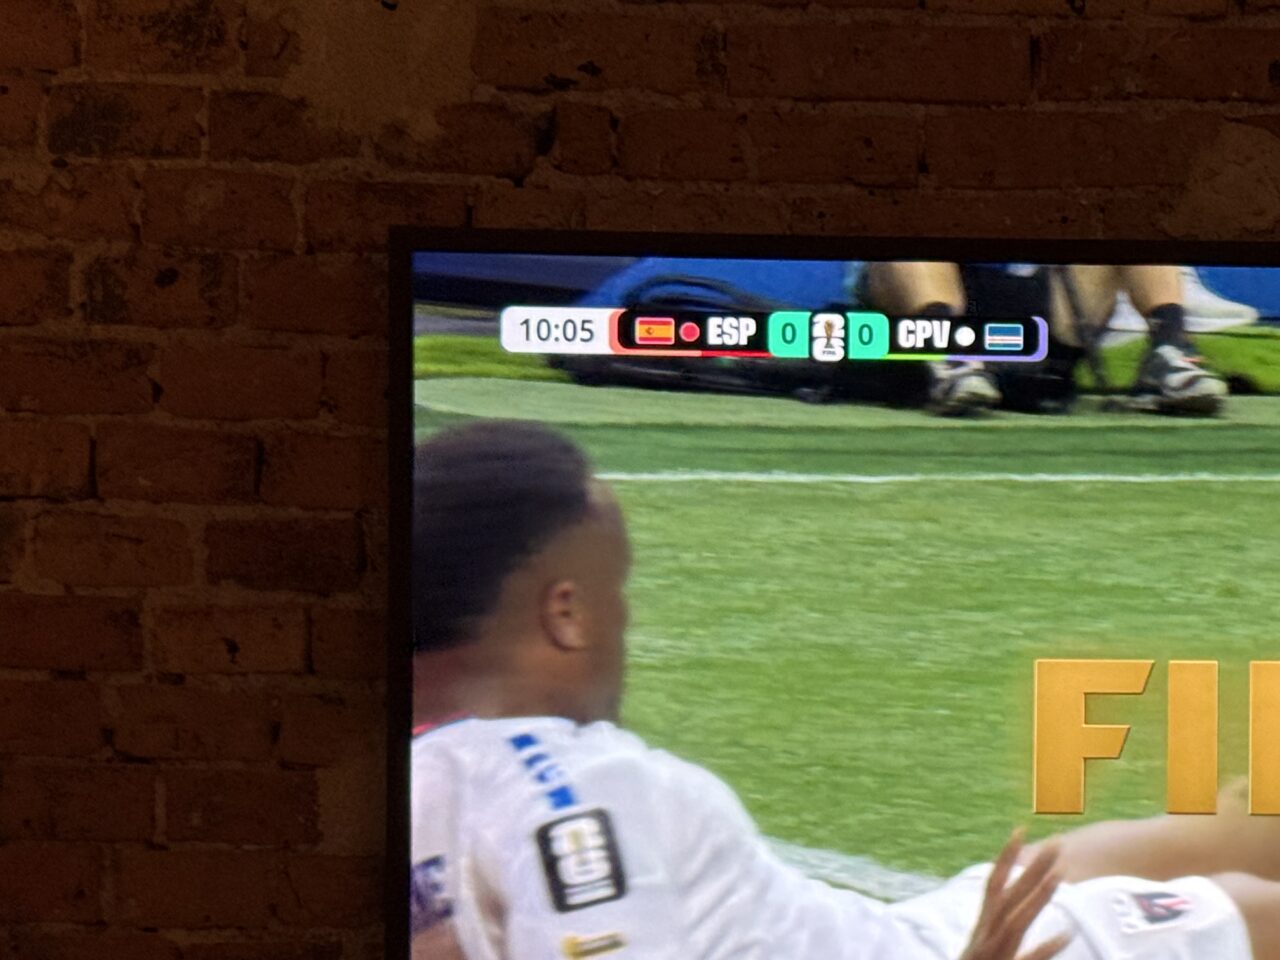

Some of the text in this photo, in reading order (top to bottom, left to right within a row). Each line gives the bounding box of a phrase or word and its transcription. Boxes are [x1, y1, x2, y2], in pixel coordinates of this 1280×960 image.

[519, 318, 595, 343] 10:05
[706, 316, 758, 346] ESP
[781, 322, 797, 345] 0
[857, 324, 874, 347] 0
[897, 318, 951, 349] CPV
